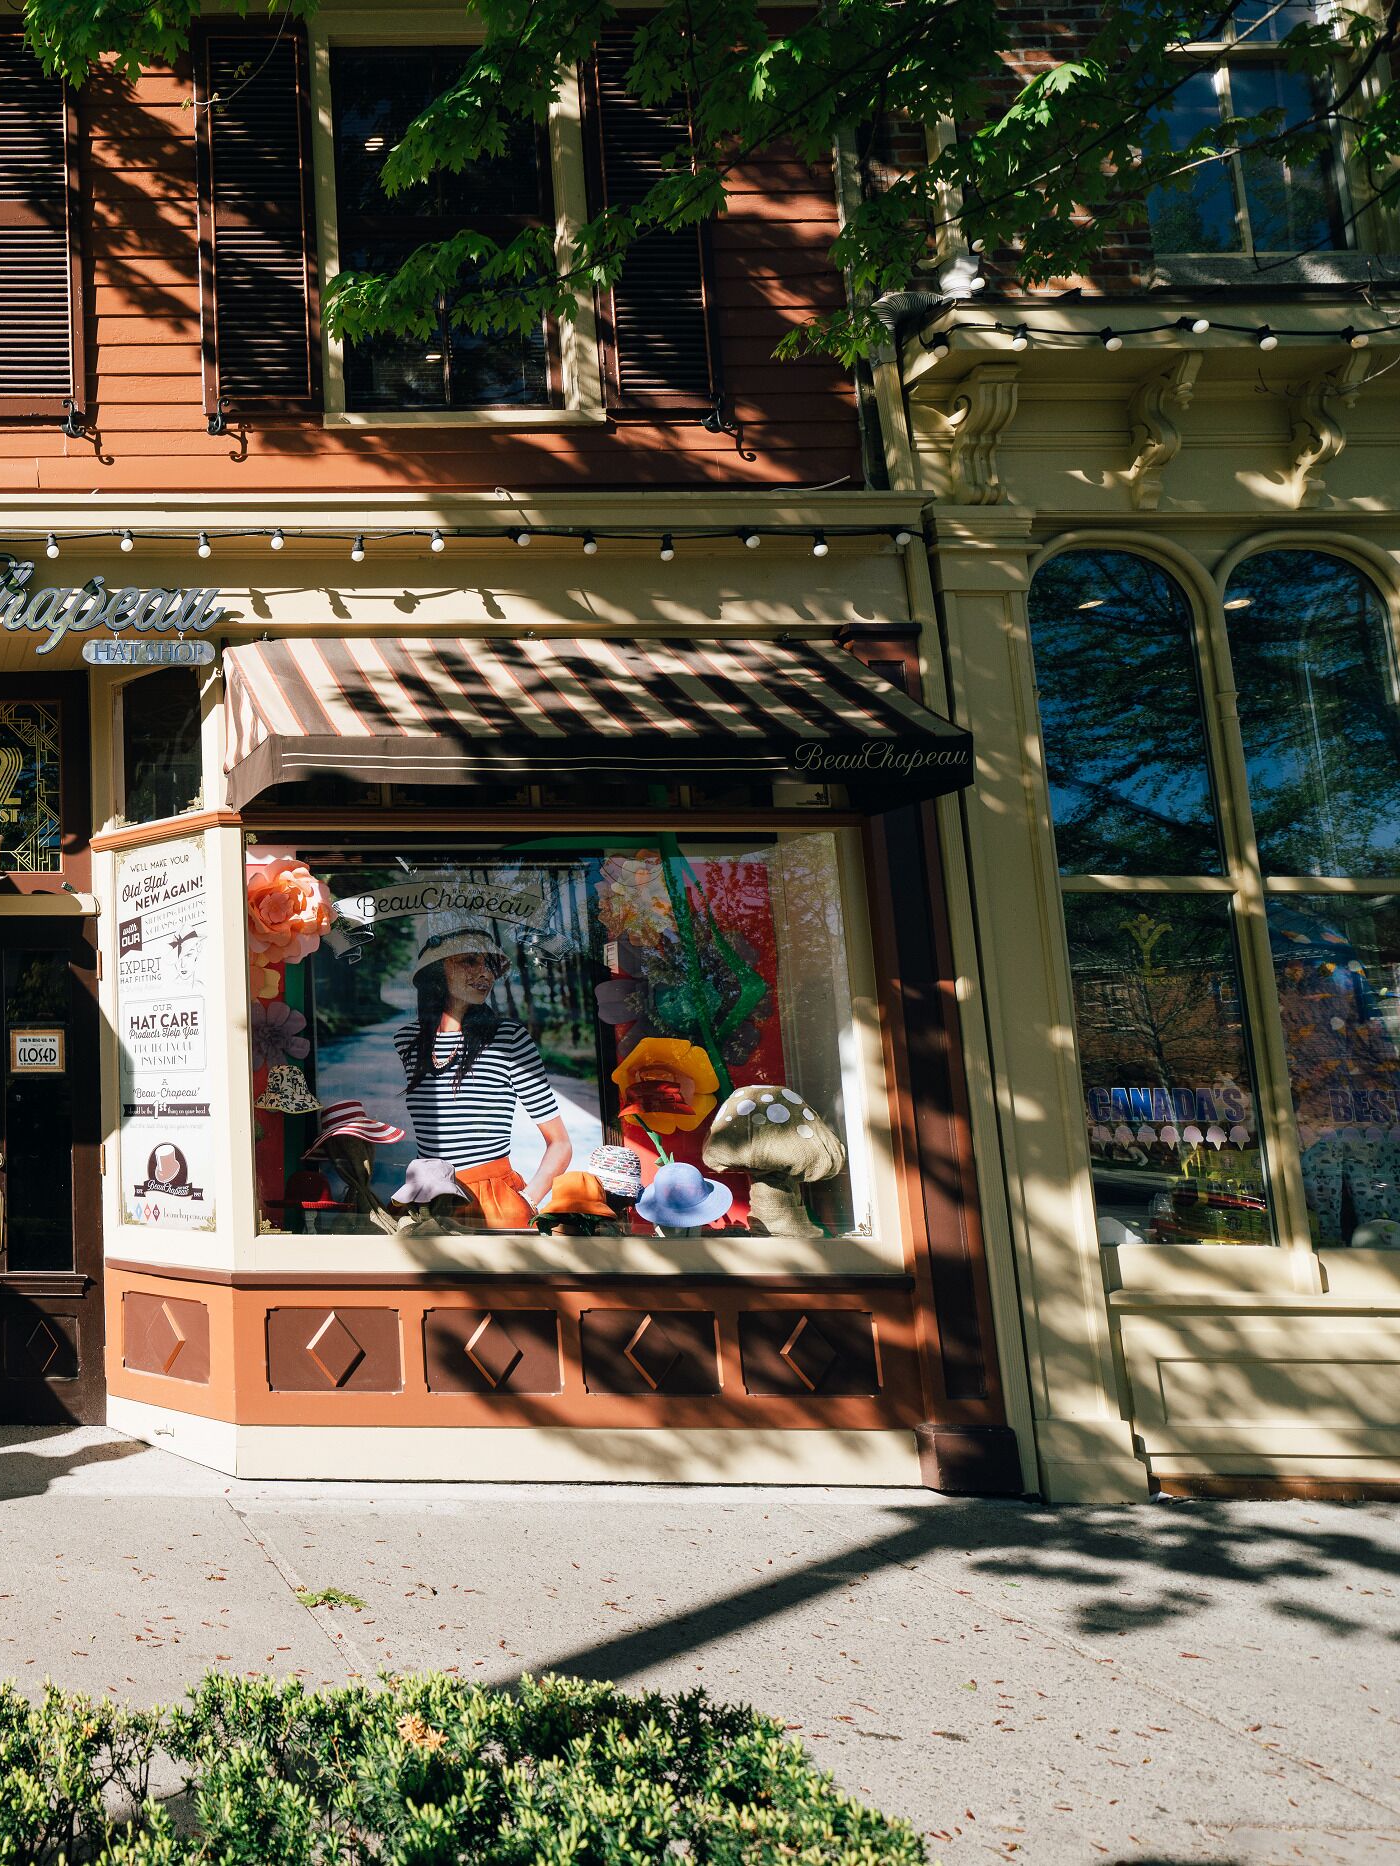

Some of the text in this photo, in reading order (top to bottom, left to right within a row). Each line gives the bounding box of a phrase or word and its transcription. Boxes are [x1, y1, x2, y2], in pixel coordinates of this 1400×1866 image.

[93, 642, 205, 662] HAT SHOP
[0, 808, 20, 823] ST
[150, 858, 168, 870] MAKE
[170, 854, 190, 865] YOUR
[122, 871, 169, 903] Old Hat
[135, 875, 204, 912] NEW AGAIN!
[122, 922, 138, 936] with
[121, 932, 140, 948] OUR
[120, 956, 162, 975] EXPERT
[120, 973, 162, 984] HAT FITTING
[153, 1003, 173, 1012] OUR
[130, 1011, 199, 1030] HAT CARE
[129, 1026, 200, 1040] Products Help You
[18, 1047, 57, 1063] CLOSED
[161, 1078, 169, 1086] A
[141, 1106, 146, 1114] be
[152, 1099, 168, 1120] 1st
[167, 1106, 178, 1116] thing
[195, 1105, 206, 1114] head
[1087, 1087, 1248, 1122] CANADA'S
